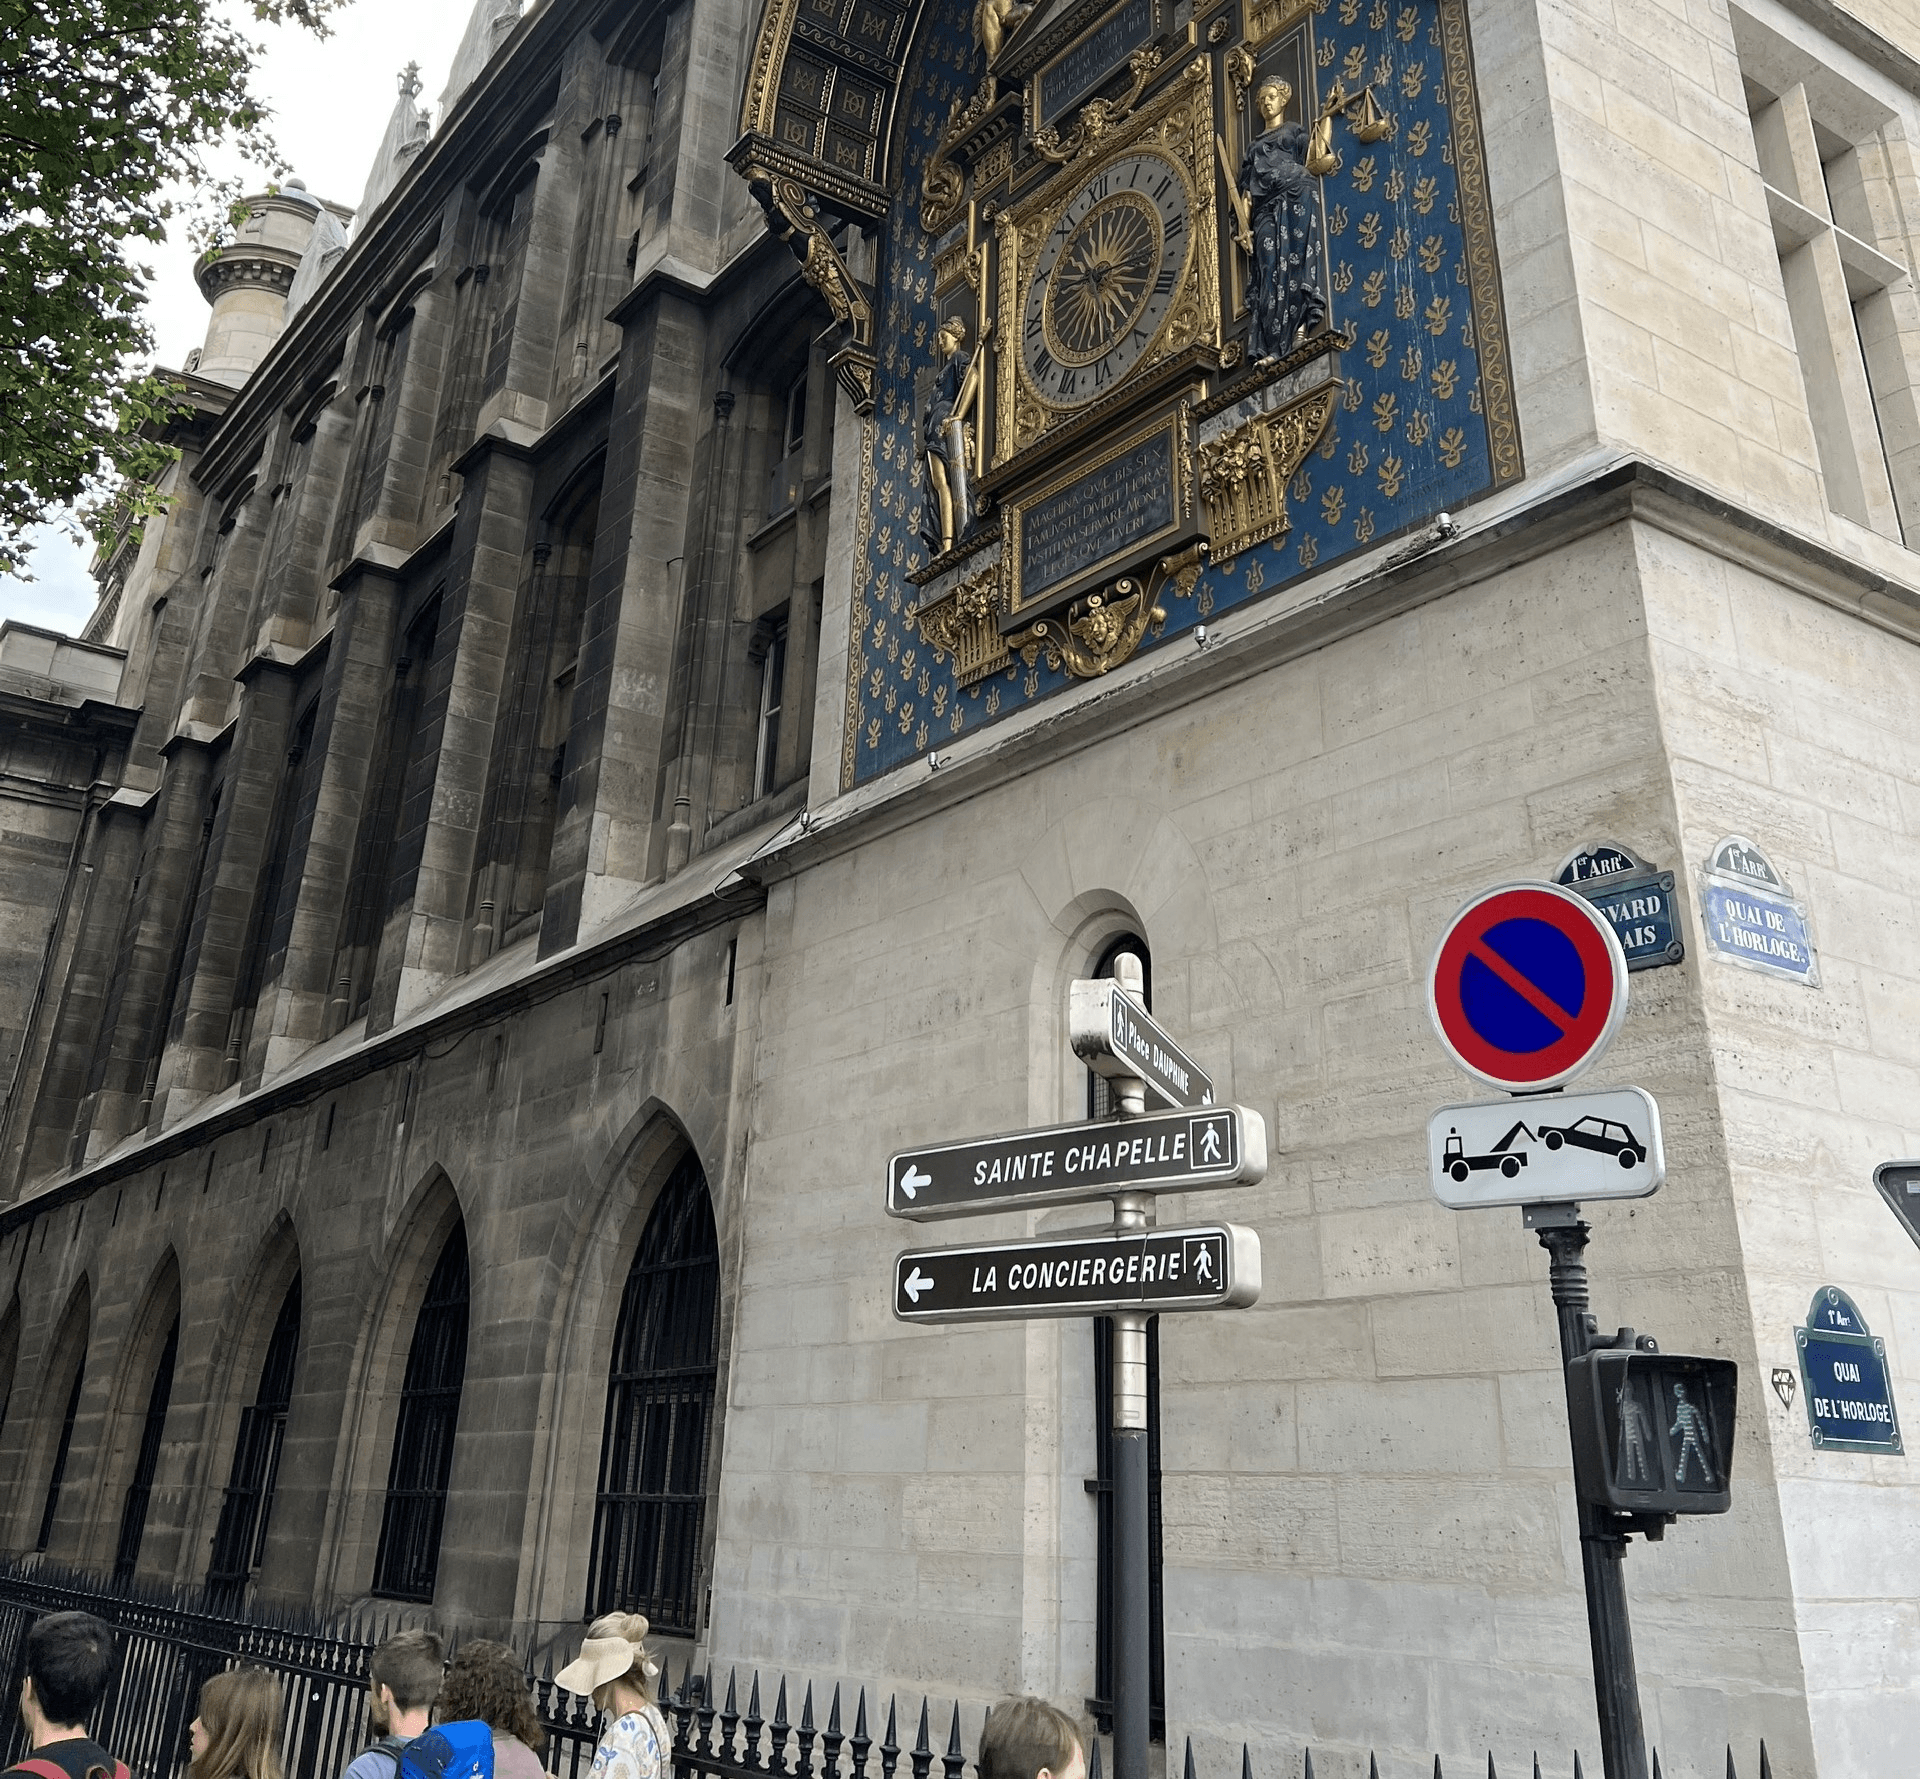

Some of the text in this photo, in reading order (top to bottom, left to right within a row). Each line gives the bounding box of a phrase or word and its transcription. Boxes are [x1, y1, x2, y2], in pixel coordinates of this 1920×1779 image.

[1087, 175, 1109, 211] XII
[1152, 175, 1173, 202] II
[1726, 899, 1786, 932] QUAI DE
[1622, 925, 1656, 949] AIS
[1128, 1021, 1190, 1096] Place DAUPHINE
[973, 1132, 1187, 1186] SAINTE CHAPELLE
[972, 1252, 1181, 1293] LA CONCIERGERIE
[1833, 1361, 1861, 1382] QUAI
[1814, 1397, 1891, 1423] DE L'HORLOGE
